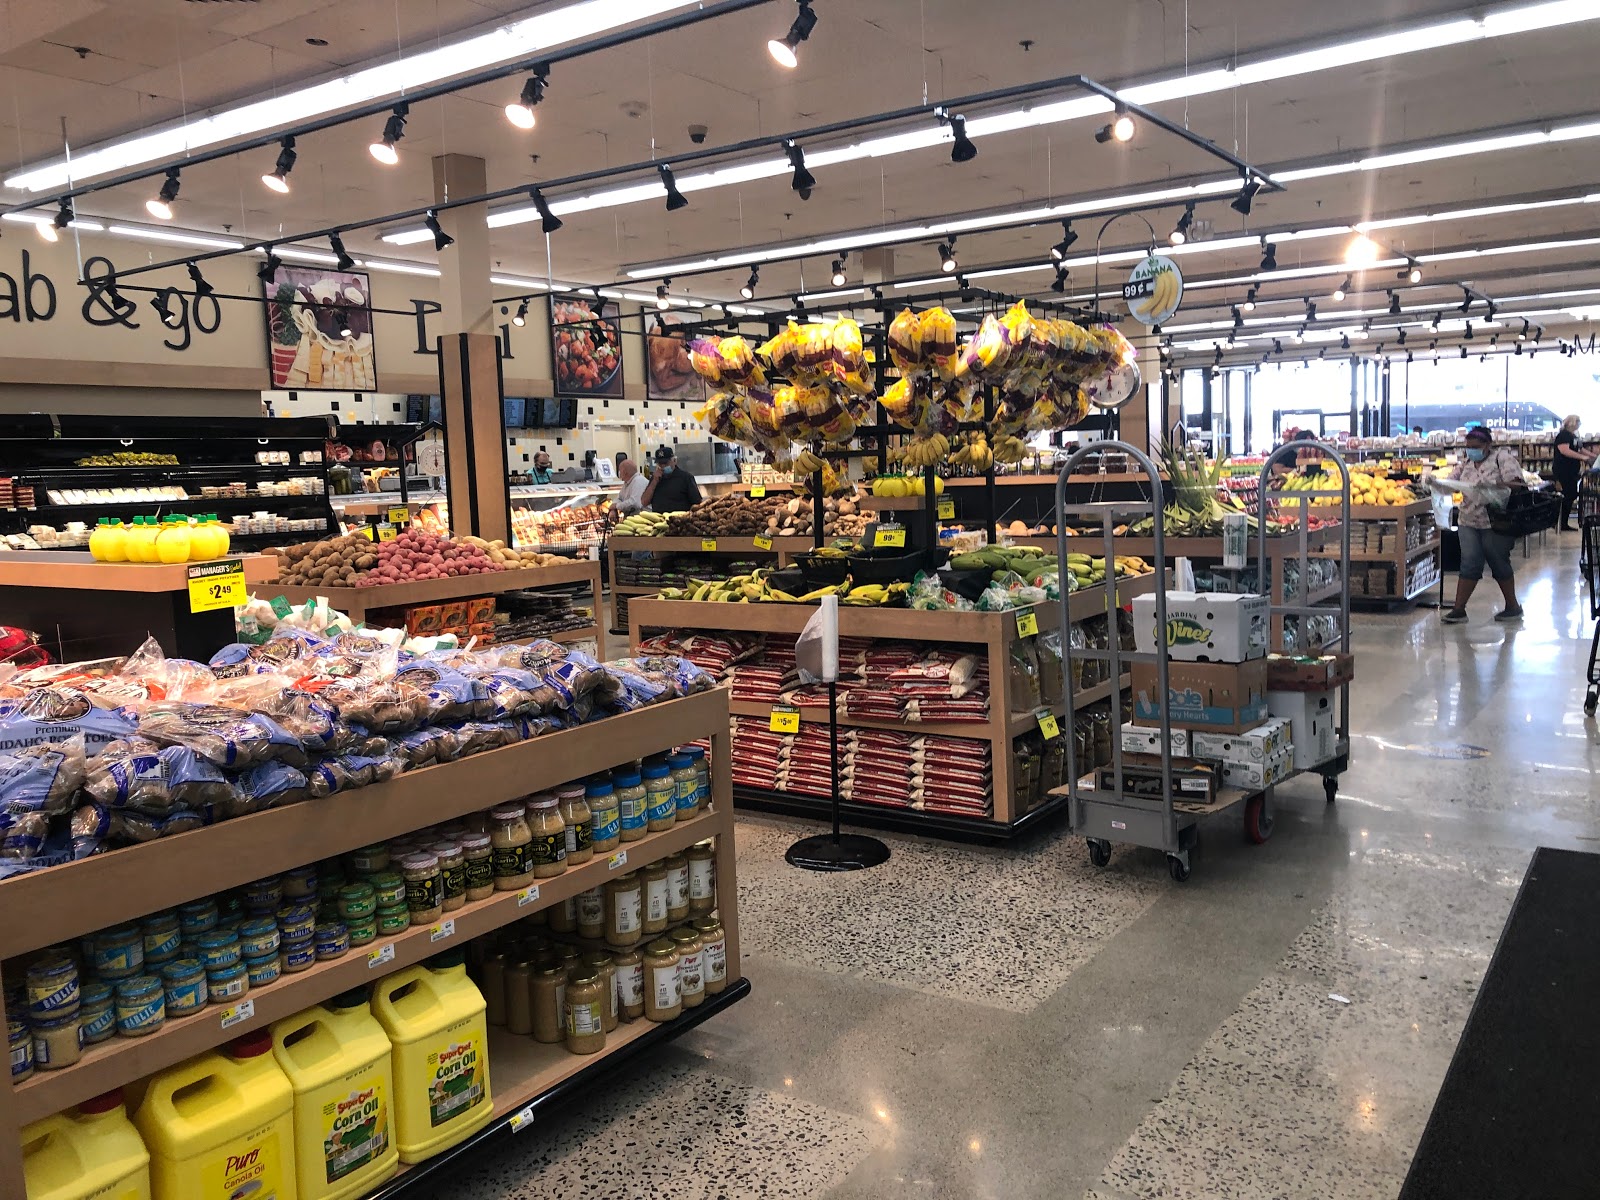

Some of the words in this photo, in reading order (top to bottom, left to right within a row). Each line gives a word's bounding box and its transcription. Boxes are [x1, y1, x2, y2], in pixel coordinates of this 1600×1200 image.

[1135, 264, 1173, 279] BANANA
[82, 256, 140, 329] &
[164, 286, 221, 350] go
[201, 565, 230, 575] MANAGER'S
[1183, 711, 1209, 721] Hearts
[35, 725, 81, 735] Premium
[468, 867, 489, 876] Garlic
[42, 982, 76, 1009] GARLIC
[84, 1009, 115, 1036] GARLIC
[124, 1005, 156, 1030] GARLIC
[436, 1061, 461, 1080] Corn
[462, 1049, 476, 1067] Oil
[439, 1041, 472, 1065] SuperChef
[333, 1110, 361, 1131] Corn
[363, 1096, 379, 1116] Oil
[337, 1087, 374, 1115] SuperChef
[224, 1146, 263, 1177] Puro
[224, 1171, 253, 1190] Canola
[254, 1163, 265, 1175] Oil
